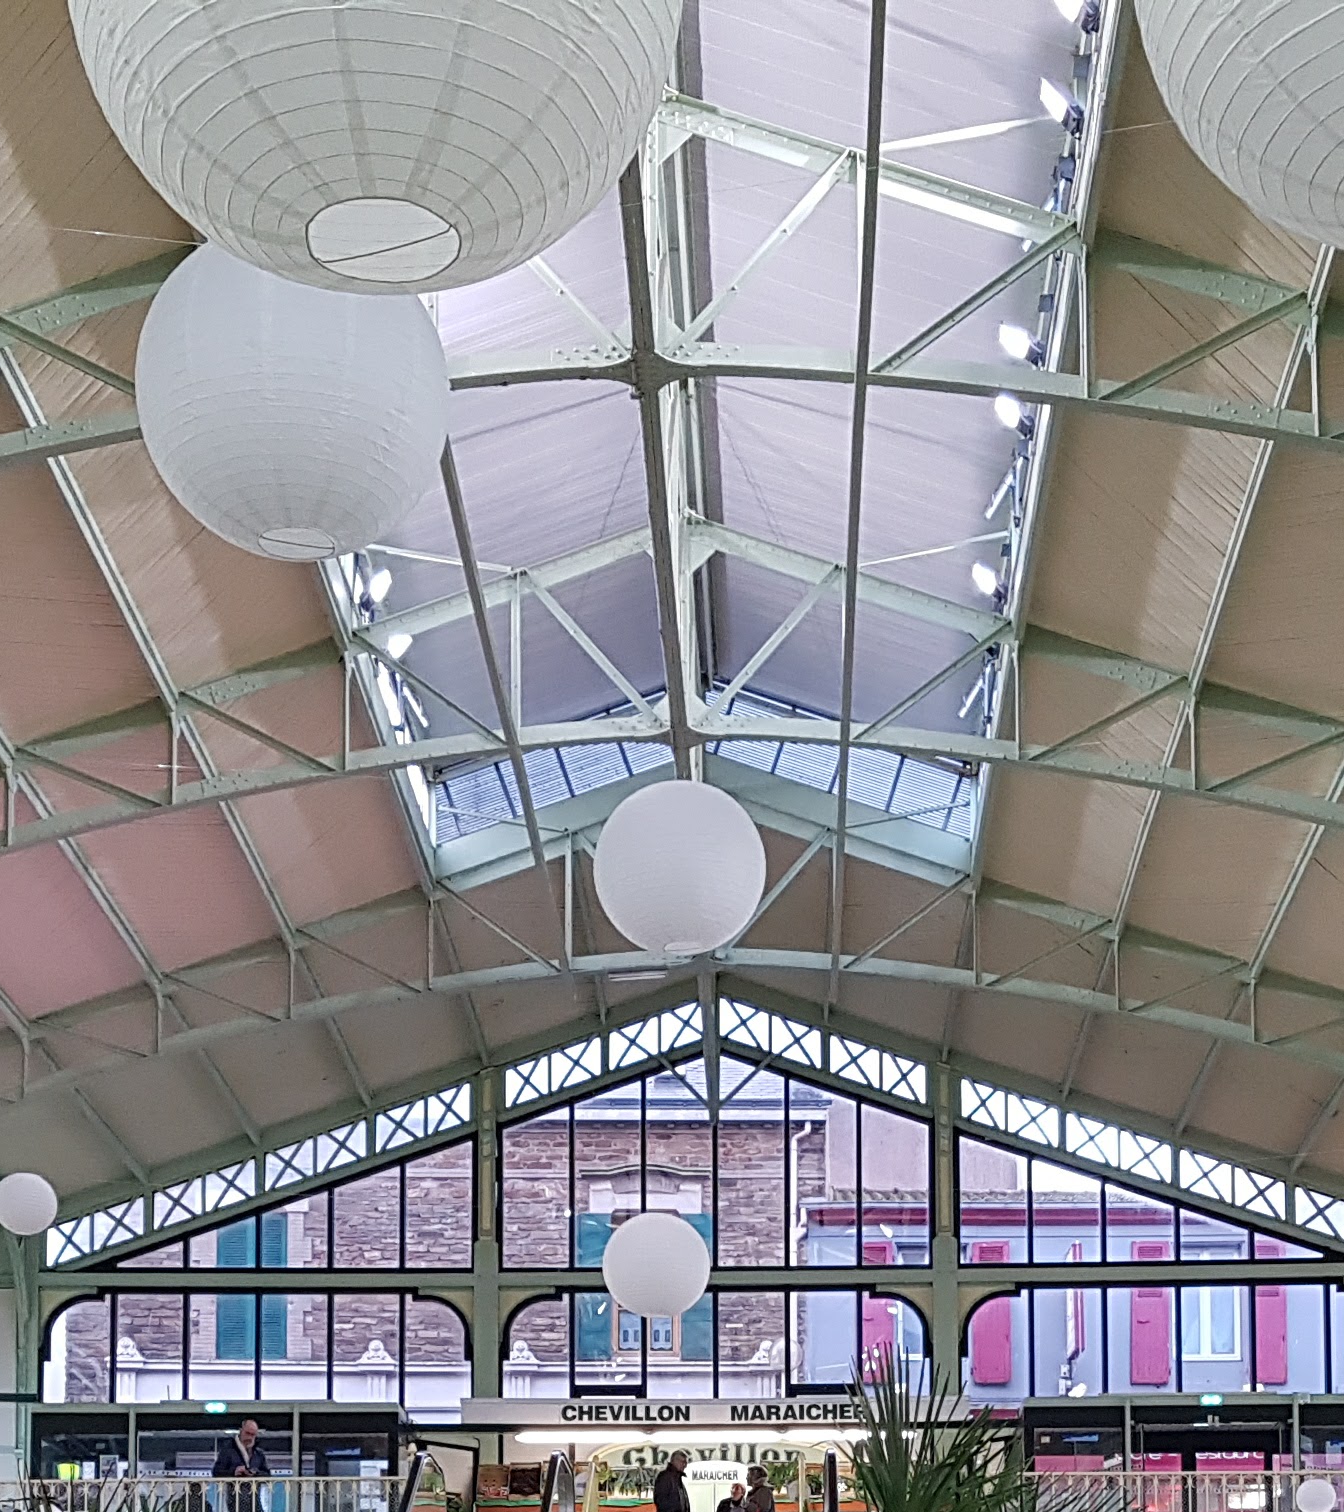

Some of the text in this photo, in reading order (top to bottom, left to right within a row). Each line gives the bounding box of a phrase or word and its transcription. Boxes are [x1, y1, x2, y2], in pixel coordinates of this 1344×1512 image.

[561, 1403, 868, 1422] CHEVILLON MARAICHER
[691, 1469, 739, 1481] MARAICHER
